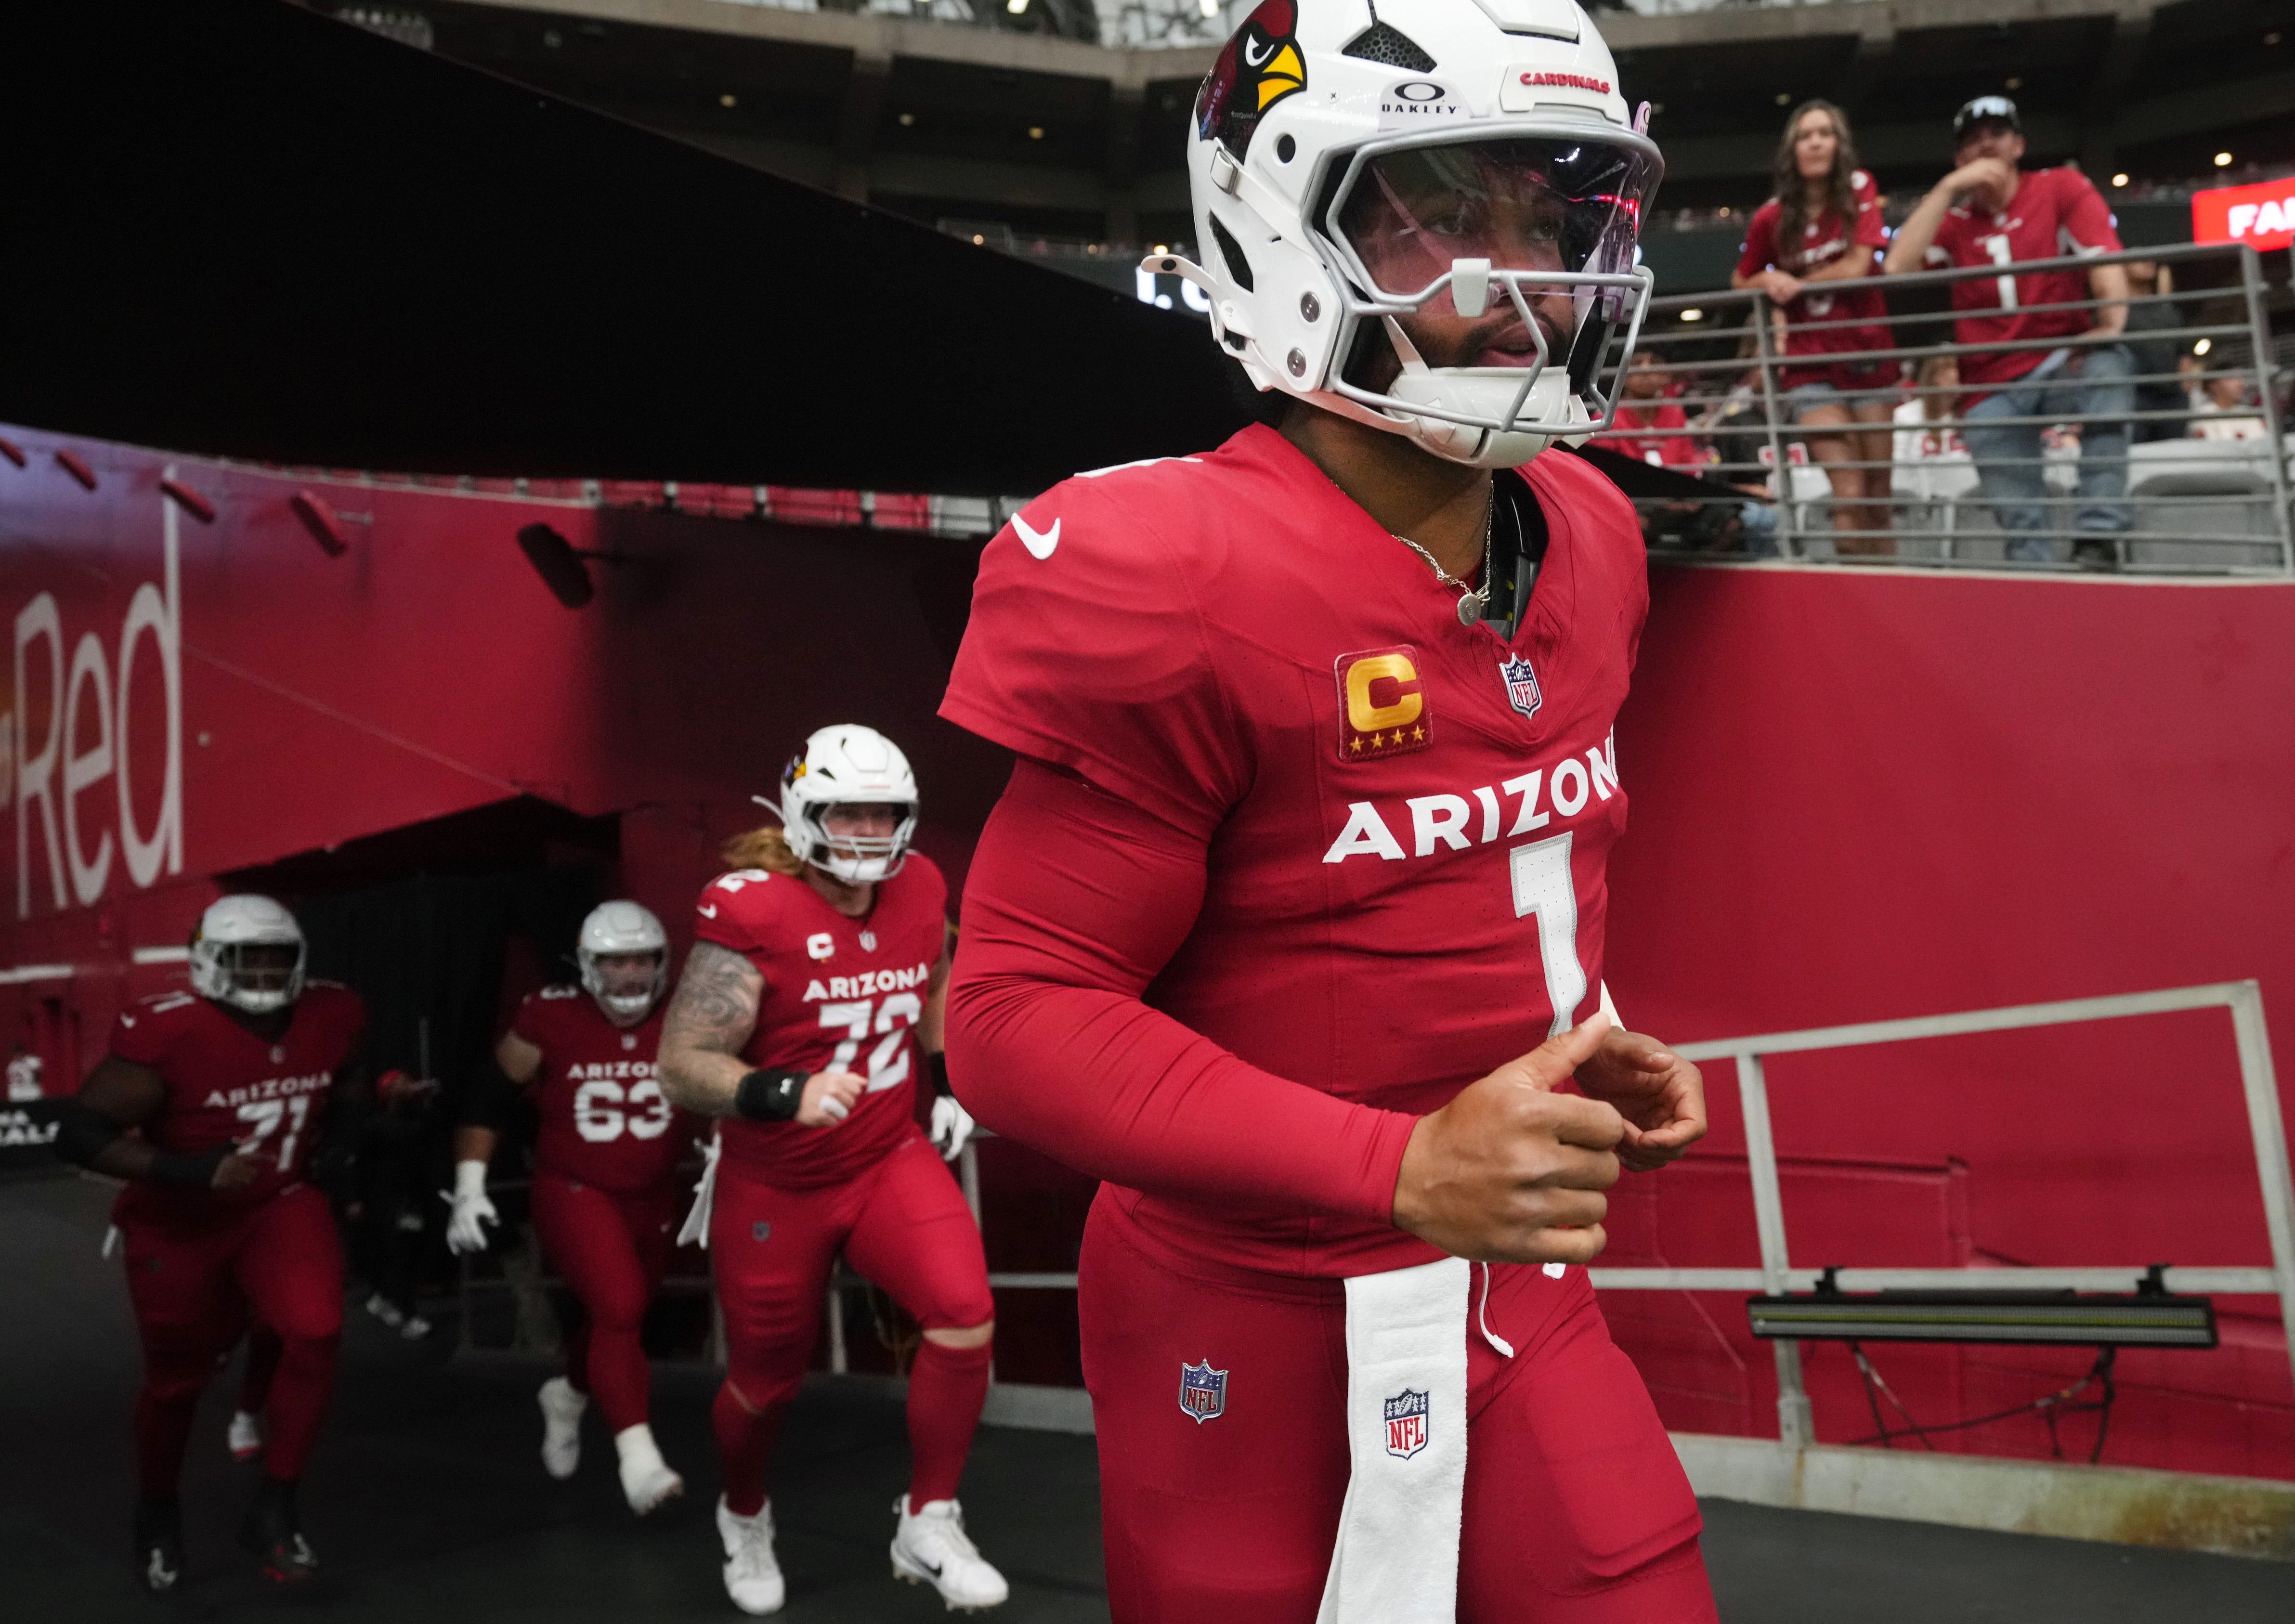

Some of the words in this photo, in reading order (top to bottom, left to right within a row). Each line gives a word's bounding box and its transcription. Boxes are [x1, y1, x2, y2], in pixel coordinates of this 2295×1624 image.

[1520, 73, 1611, 94] CARDINALS
[1382, 104, 1457, 114] OAKLEY
[14, 463, 183, 920] Red
[1346, 652, 1423, 733] C
[1513, 682, 1538, 707] NFL
[1322, 723, 1618, 863] ARIZON
[806, 932, 835, 960] C
[1509, 830, 1588, 1041] 1
[802, 961, 928, 1002] ARIZONA
[819, 991, 922, 1093] 72
[202, 1069, 333, 1108] ARIZONA
[565, 1060, 659, 1080] ARIZO
[574, 1079, 674, 1143] 63
[235, 1094, 311, 1173] 71
[1185, 1387, 1218, 1413] NFL
[1388, 1416, 1424, 1451] NFL
